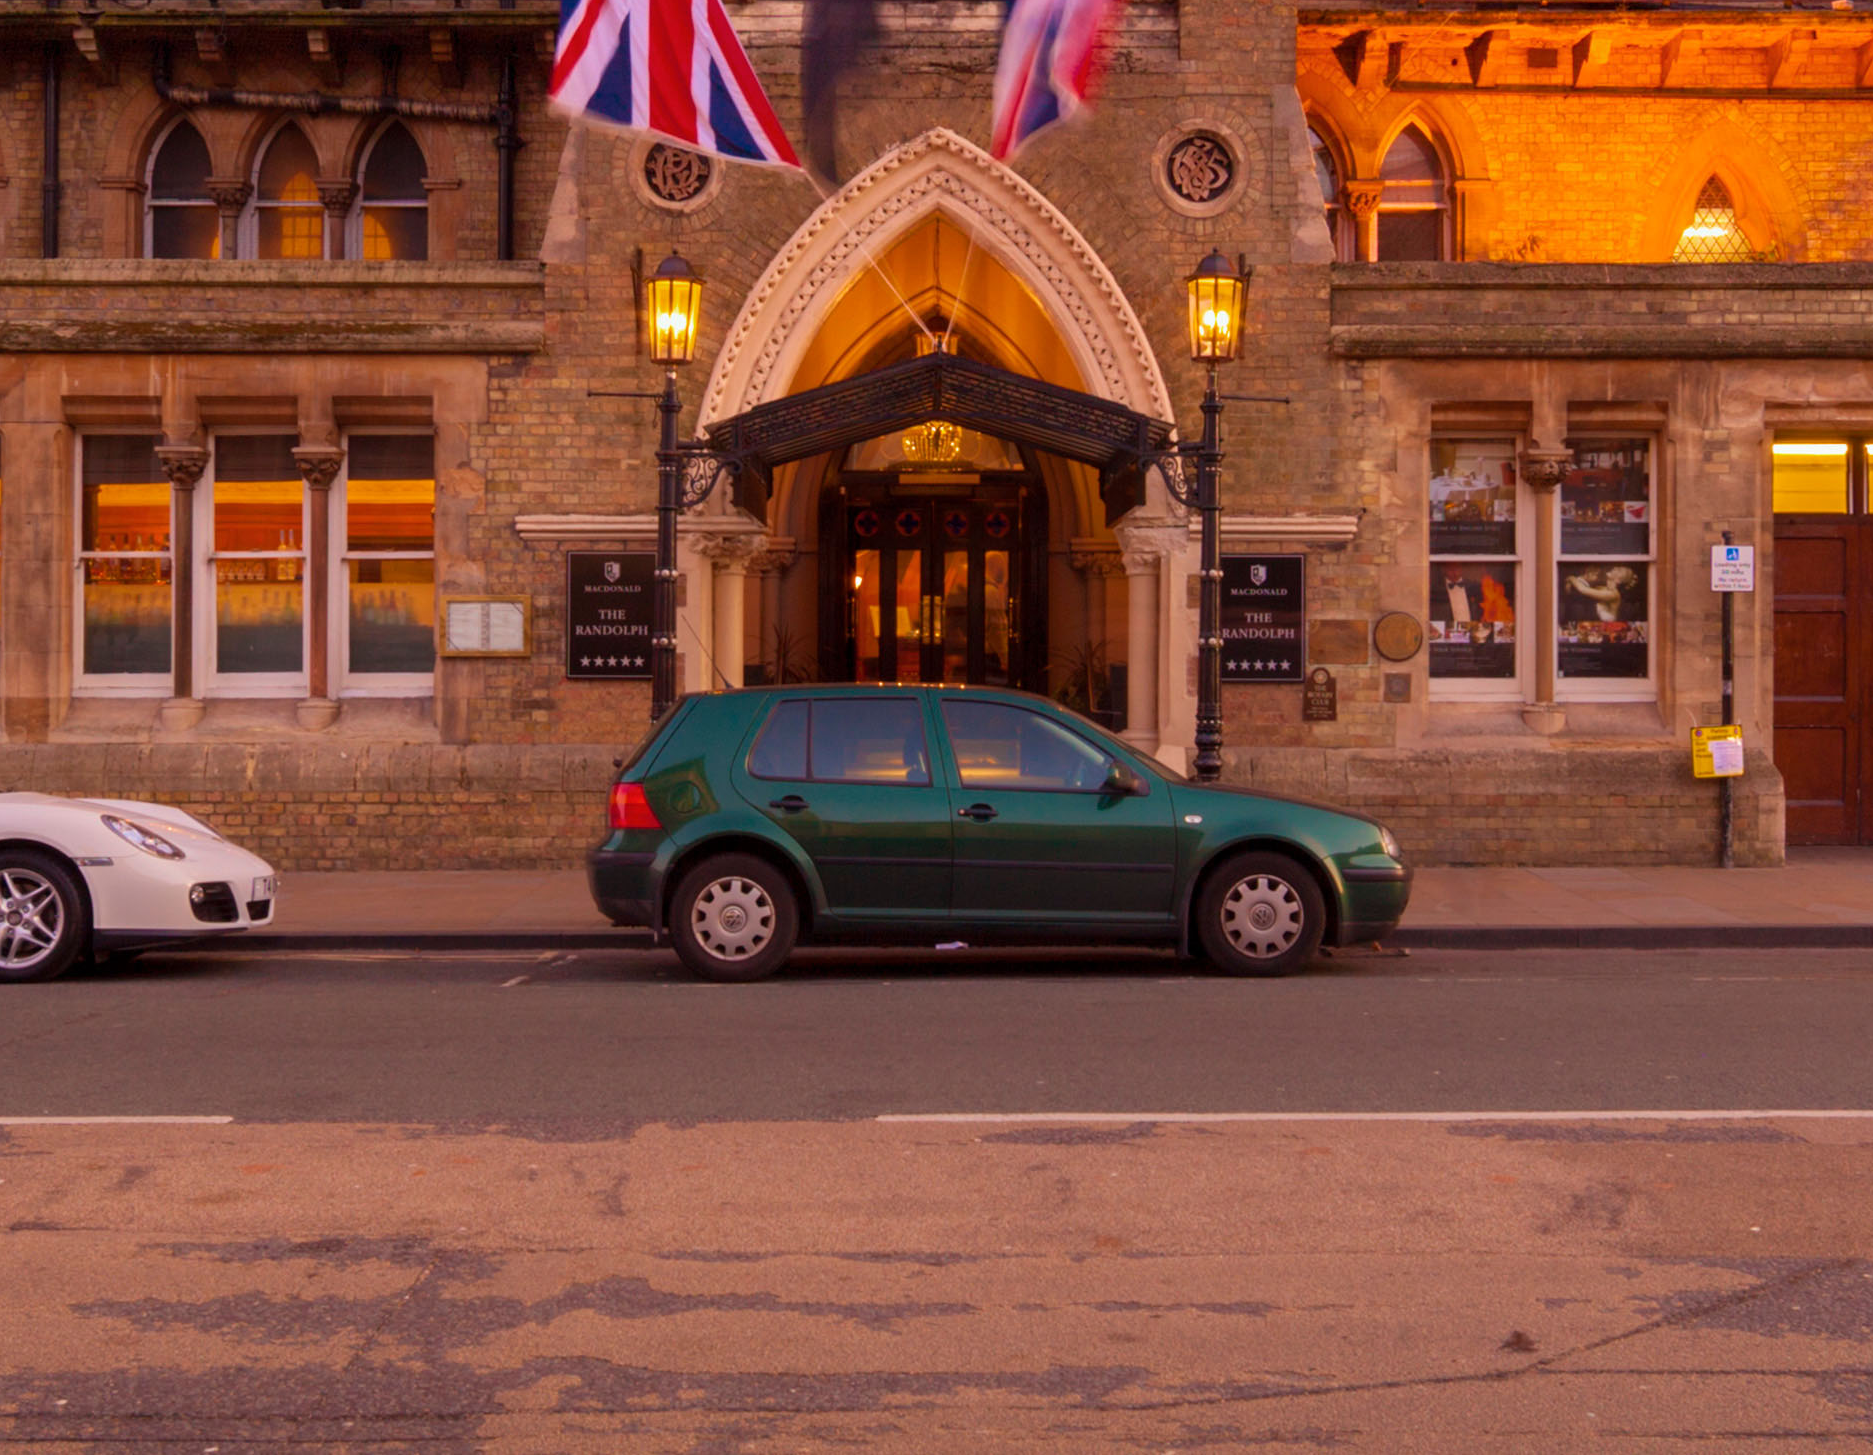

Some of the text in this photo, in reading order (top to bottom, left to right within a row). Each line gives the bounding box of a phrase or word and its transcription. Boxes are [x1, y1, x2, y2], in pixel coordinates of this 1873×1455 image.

[583, 585, 642, 593] MACDONALD
[1229, 588, 1288, 596] MACDONALD
[597, 609, 627, 620] THE
[1244, 612, 1273, 623] THE
[574, 625, 649, 636] RANDOLPH
[1222, 628, 1295, 639] RANDOLPH
